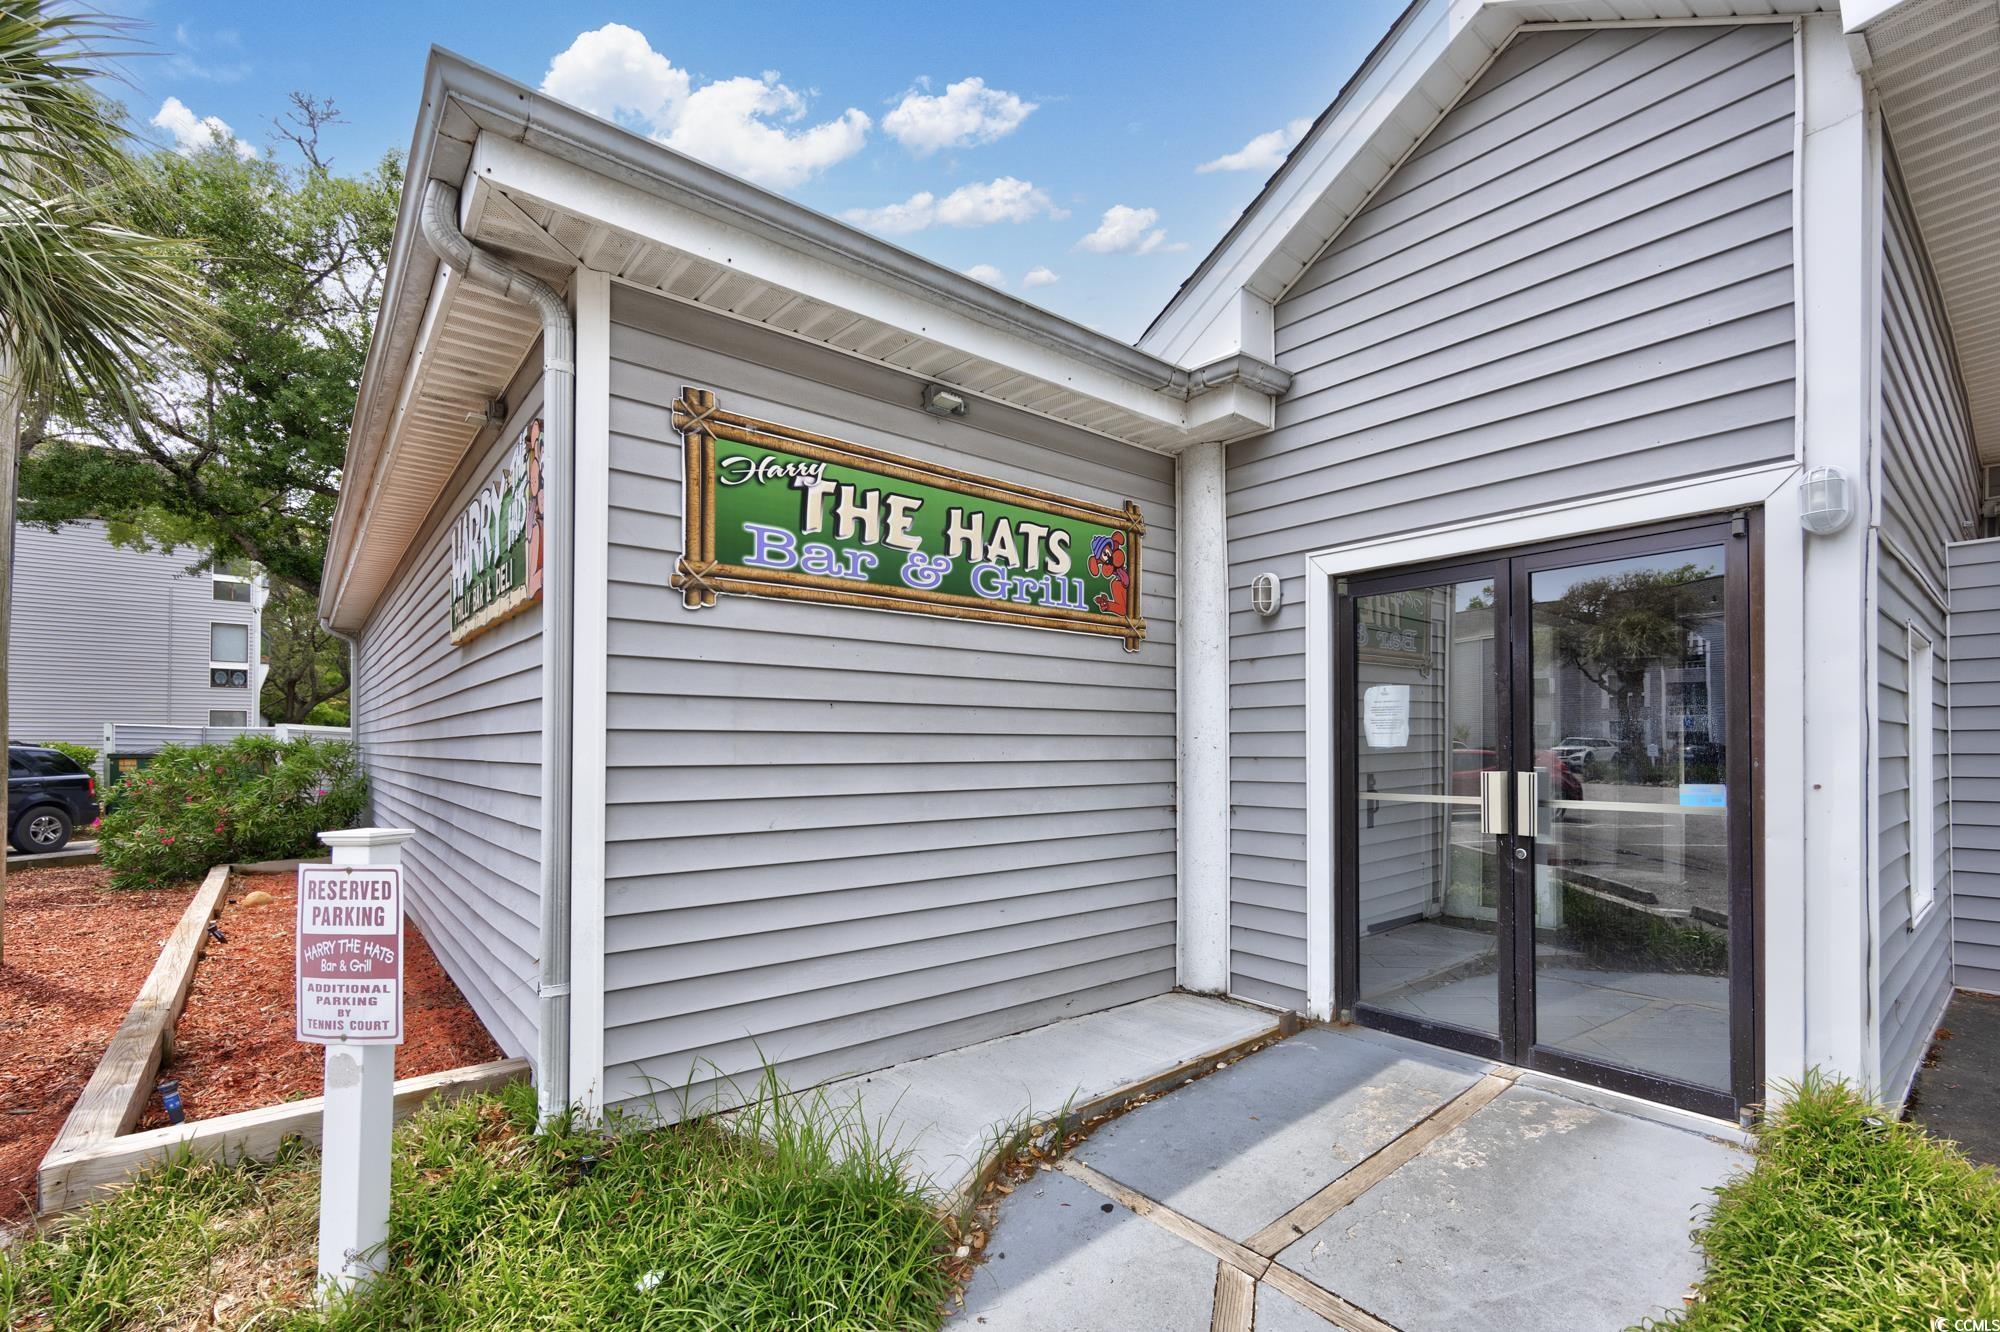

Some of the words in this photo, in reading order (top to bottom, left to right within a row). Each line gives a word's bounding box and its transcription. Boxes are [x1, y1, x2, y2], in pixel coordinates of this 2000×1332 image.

[720, 456, 827, 487] Harry
[793, 475, 923, 551] THE
[947, 508, 1071, 575] HATS
[452, 469, 506, 603] HARRY
[744, 523, 878, 579] Bar
[901, 551, 952, 590] &
[971, 563, 1089, 611] Grill
[486, 576, 491, 602] &
[496, 558, 512, 596] DELI
[308, 880, 392, 901] RESERVED
[312, 906, 385, 927] PARKING
[304, 940, 336, 963] HARRY
[338, 938, 361, 954] THE
[364, 941, 395, 964] HATS
[321, 959, 337, 972] Bar
[339, 960, 347, 972] &
[350, 958, 372, 973] Grill
[307, 983, 391, 993] ADDITIONAL
[316, 996, 378, 1006] PARKING
[338, 1009, 351, 1018] BY
[308, 1018, 344, 1030] TENNIS
[350, 1020, 390, 1031] COURT
